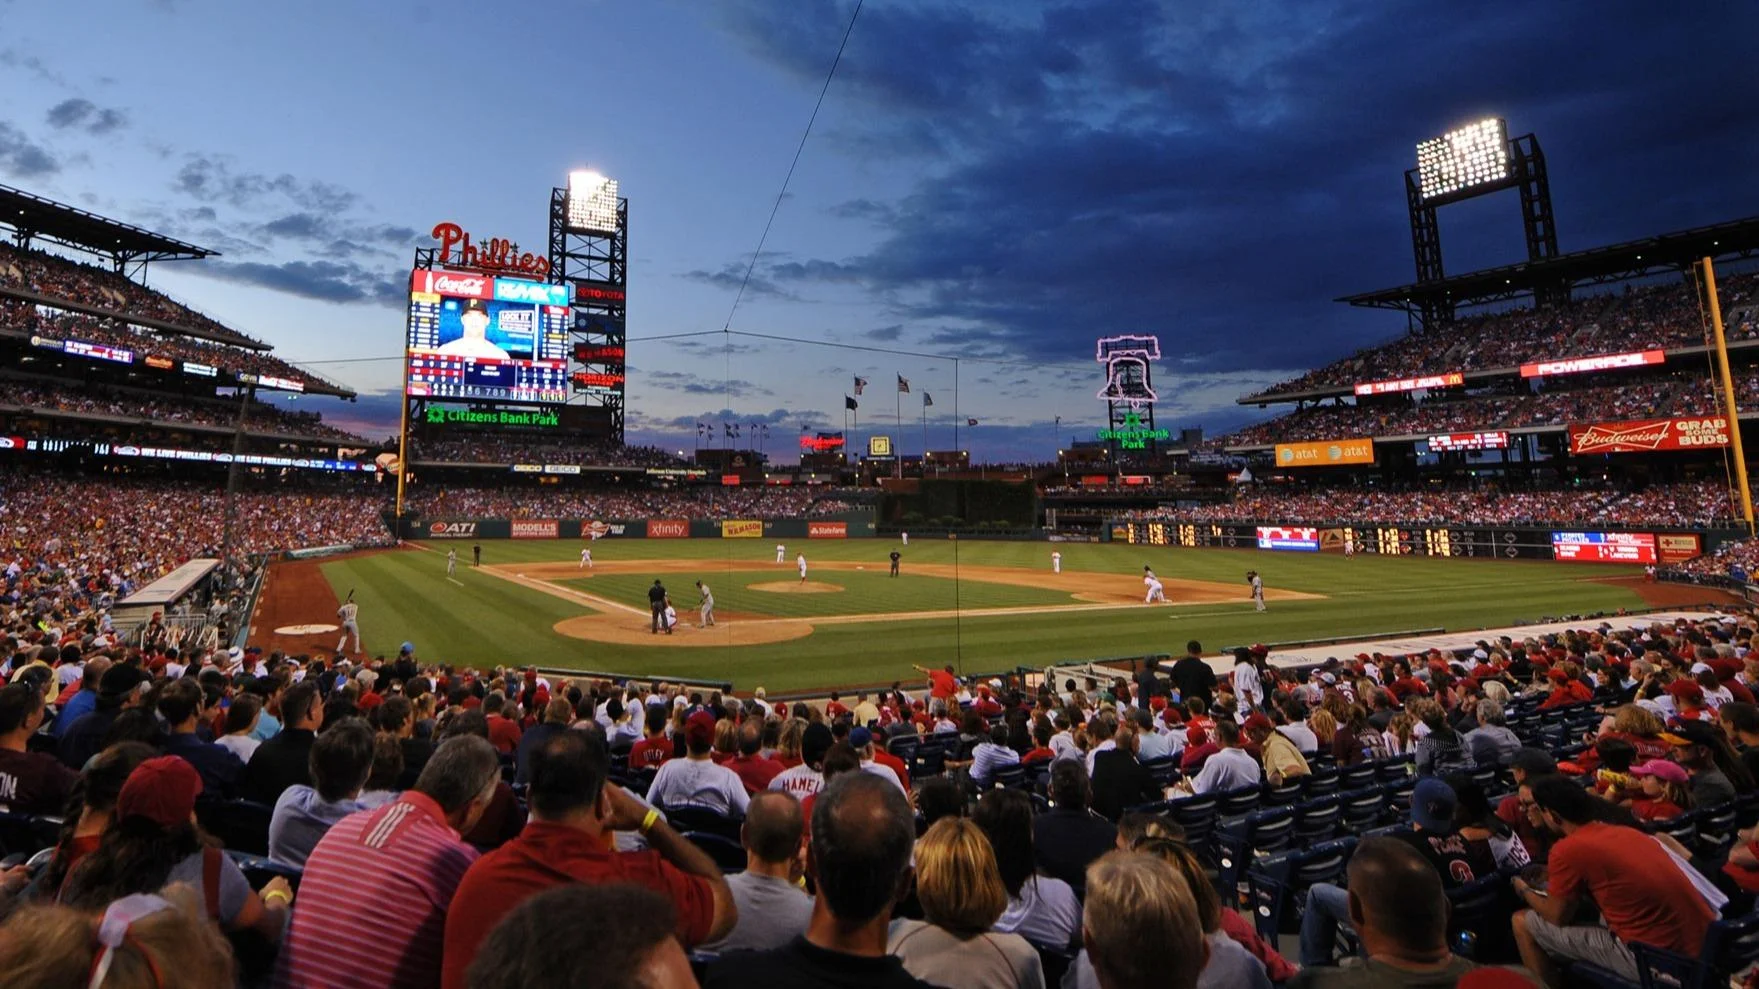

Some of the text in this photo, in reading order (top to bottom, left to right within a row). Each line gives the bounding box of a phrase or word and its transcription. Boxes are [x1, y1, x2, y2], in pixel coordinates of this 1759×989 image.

[432, 222, 551, 273] Phillies
[589, 288, 624, 300] TOYOTA
[1538, 353, 1647, 376] POWERADE
[574, 372, 624, 383] HORIZON
[448, 410, 558, 425] Citizens Bank Park
[1676, 419, 1727, 432] GRAB
[1098, 429, 1169, 440] Citizens Bank
[1573, 431, 1670, 447] Budweiser
[1680, 434, 1729, 446] BUDS
[1122, 439, 1145, 449] Park
[157, 449, 176, 458] LIVE
[177, 450, 212, 461] PHILLIES
[1296, 446, 1367, 459] at&t at&t
[446, 522, 476, 533] ATI
[512, 523, 557, 531] MODELL'S
[652, 524, 685, 536] xfinity
[643, 748, 665, 762] UTLEY
